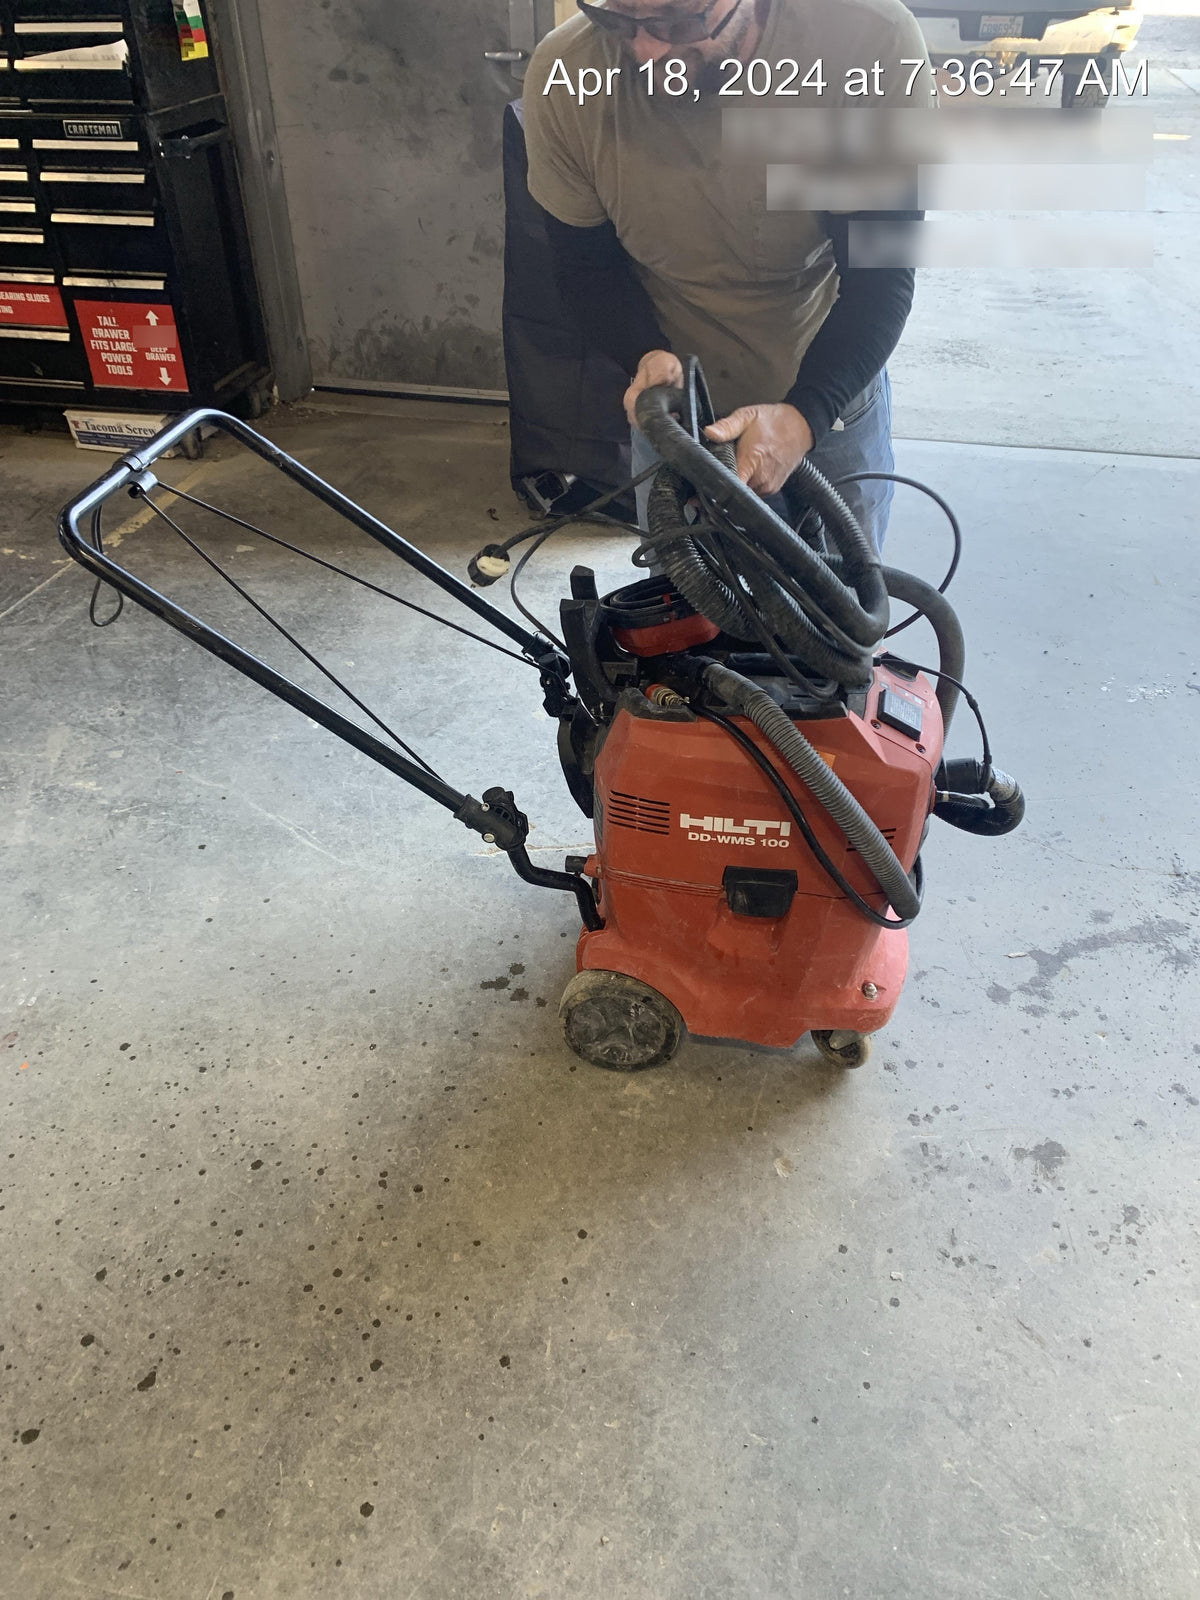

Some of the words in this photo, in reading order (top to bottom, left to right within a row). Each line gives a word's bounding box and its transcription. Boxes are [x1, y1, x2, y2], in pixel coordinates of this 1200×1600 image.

[67, 125, 119, 135] CRAFTSMAN
[0, 291, 25, 301] EARING
[25, 293, 51, 303] SLIDES
[92, 327, 131, 340] DRAWER
[90, 339, 109, 351] FITS
[101, 352, 133, 365] POWER
[145, 352, 177, 362] DRAWER
[106, 364, 134, 376] TOOLS
[82, 421, 124, 433] Tacoma
[125, 424, 157, 436] Screw
[680, 813, 791, 837] HILTI
[687, 831, 756, 846] DD-WMS
[760, 838, 790, 848] 100
